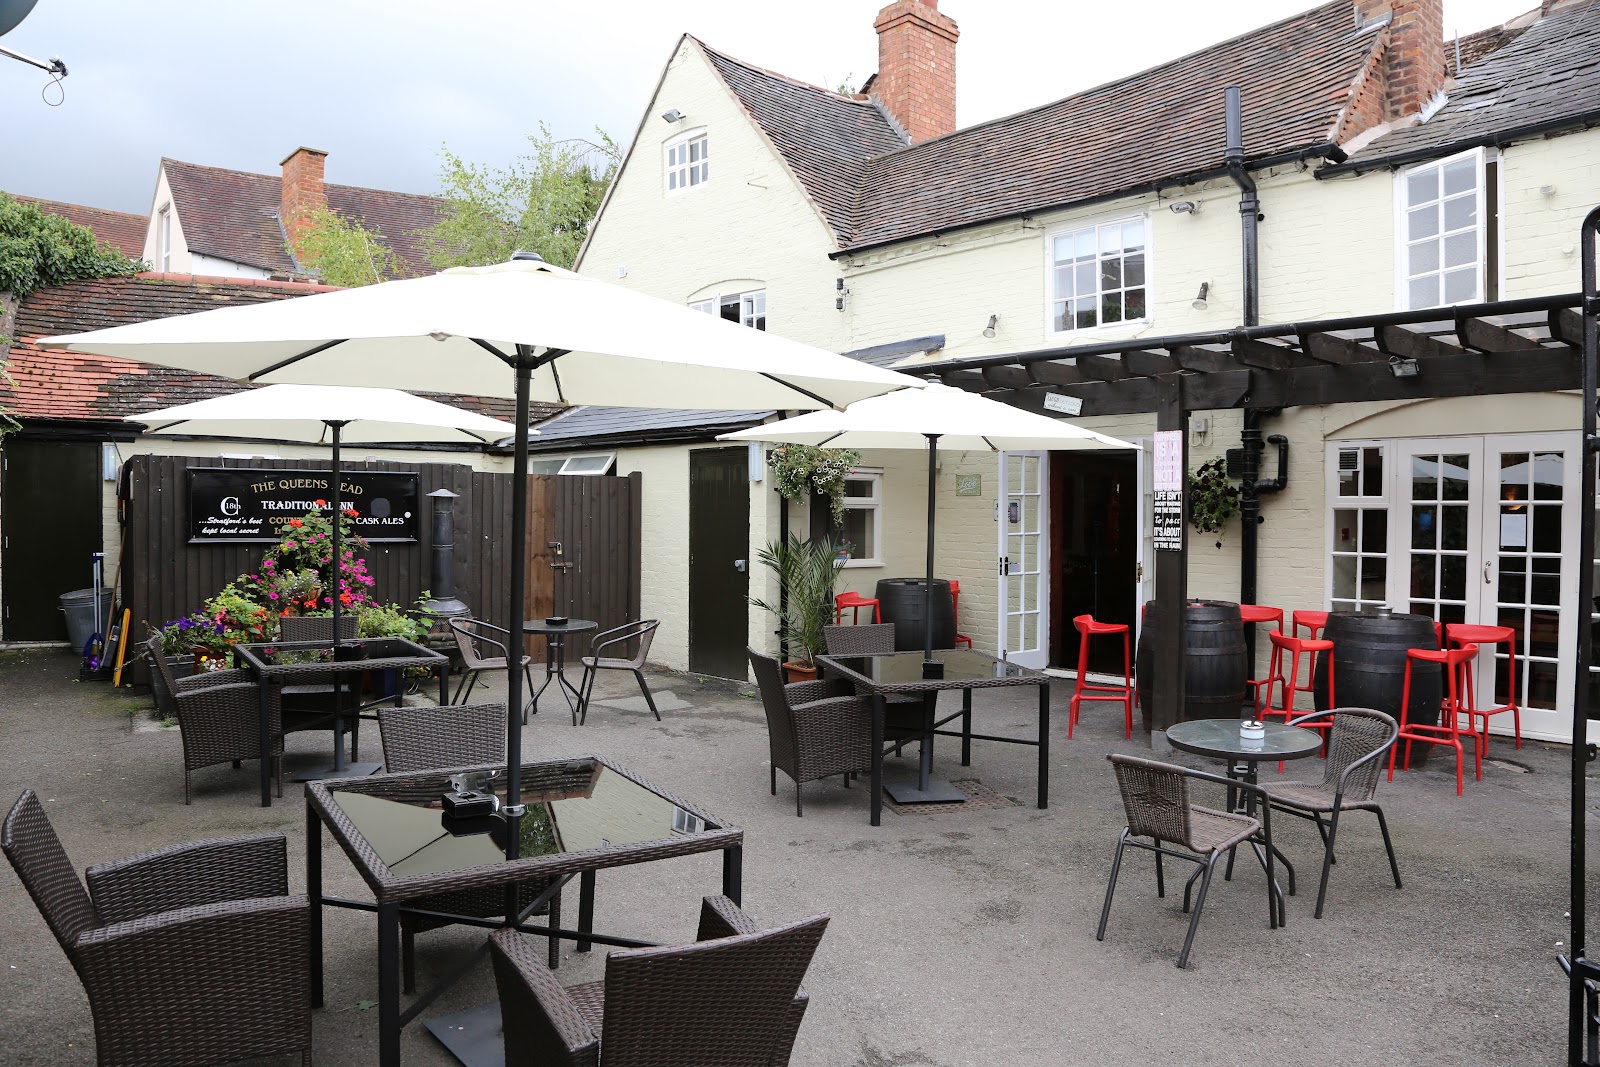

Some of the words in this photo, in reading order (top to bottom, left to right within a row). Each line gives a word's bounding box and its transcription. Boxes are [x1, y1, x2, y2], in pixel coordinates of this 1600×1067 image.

[1156, 441, 1166, 457] IS
[1171, 441, 1179, 457] A
[1155, 470, 1173, 482] NOT
[1174, 469, 1181, 482] A
[250, 481, 276, 493] THE
[278, 478, 328, 489] QUEENS
[338, 482, 363, 495] EAD
[1154, 491, 1167, 501] LIFE
[1167, 491, 1181, 501] ISN'T
[339, 501, 354, 510] NN
[248, 516, 263, 525] best
[355, 517, 380, 525] CASK
[381, 517, 405, 525] ALES
[1155, 515, 1163, 524] to
[202, 527, 219, 536] kept
[1163, 527, 1181, 537] ABOUT
